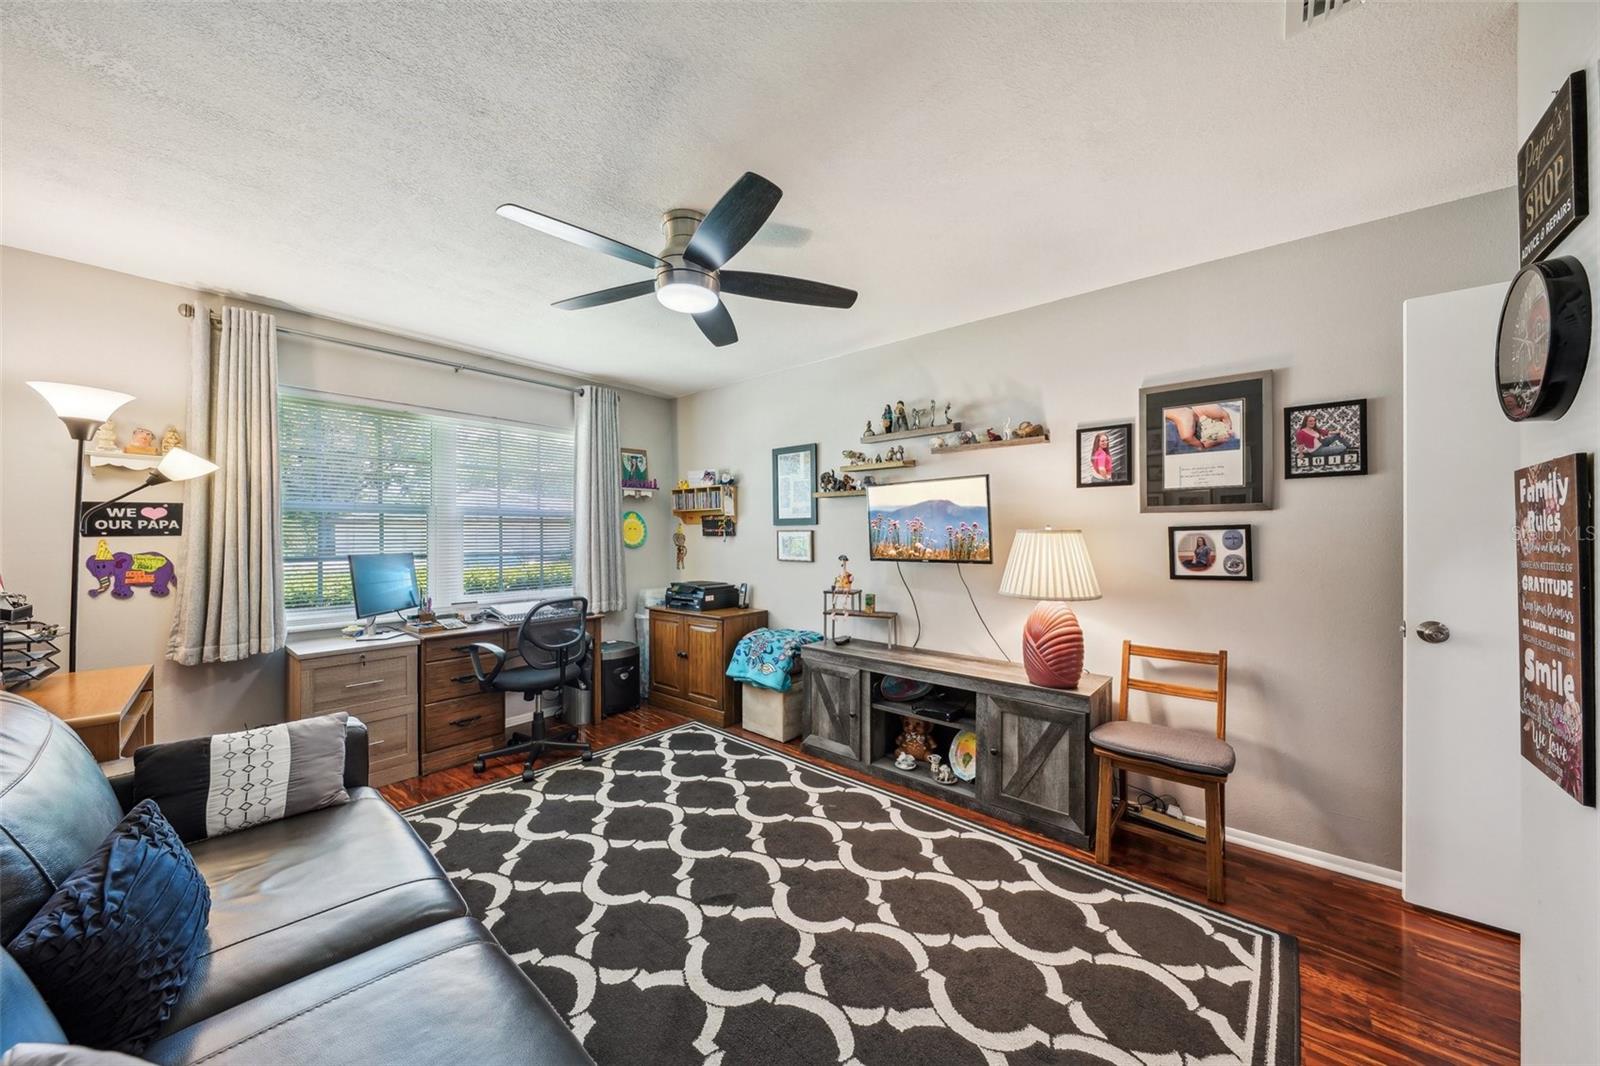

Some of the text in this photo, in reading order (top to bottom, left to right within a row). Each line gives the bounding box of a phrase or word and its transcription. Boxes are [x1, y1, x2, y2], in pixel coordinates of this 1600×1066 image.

[1522, 107, 1564, 188] Papa's
[1525, 155, 1565, 228] SHOP
[1521, 233, 1540, 262] ADVICE
[1545, 198, 1572, 233] REPAIRS
[1519, 471, 1569, 505] Family
[94, 519, 180, 530] OUR PAPA
[106, 507, 137, 517] WE
[1527, 508, 1561, 533] Rules
[1565, 563, 1573, 573] OF
[1522, 574, 1573, 599] GRATITUDE
[1522, 618, 1530, 628] WE
[1548, 625, 1557, 636] WE
[1524, 648, 1575, 703] Smile
[1531, 720, 1546, 749] We
[1548, 733, 1569, 762] Love
